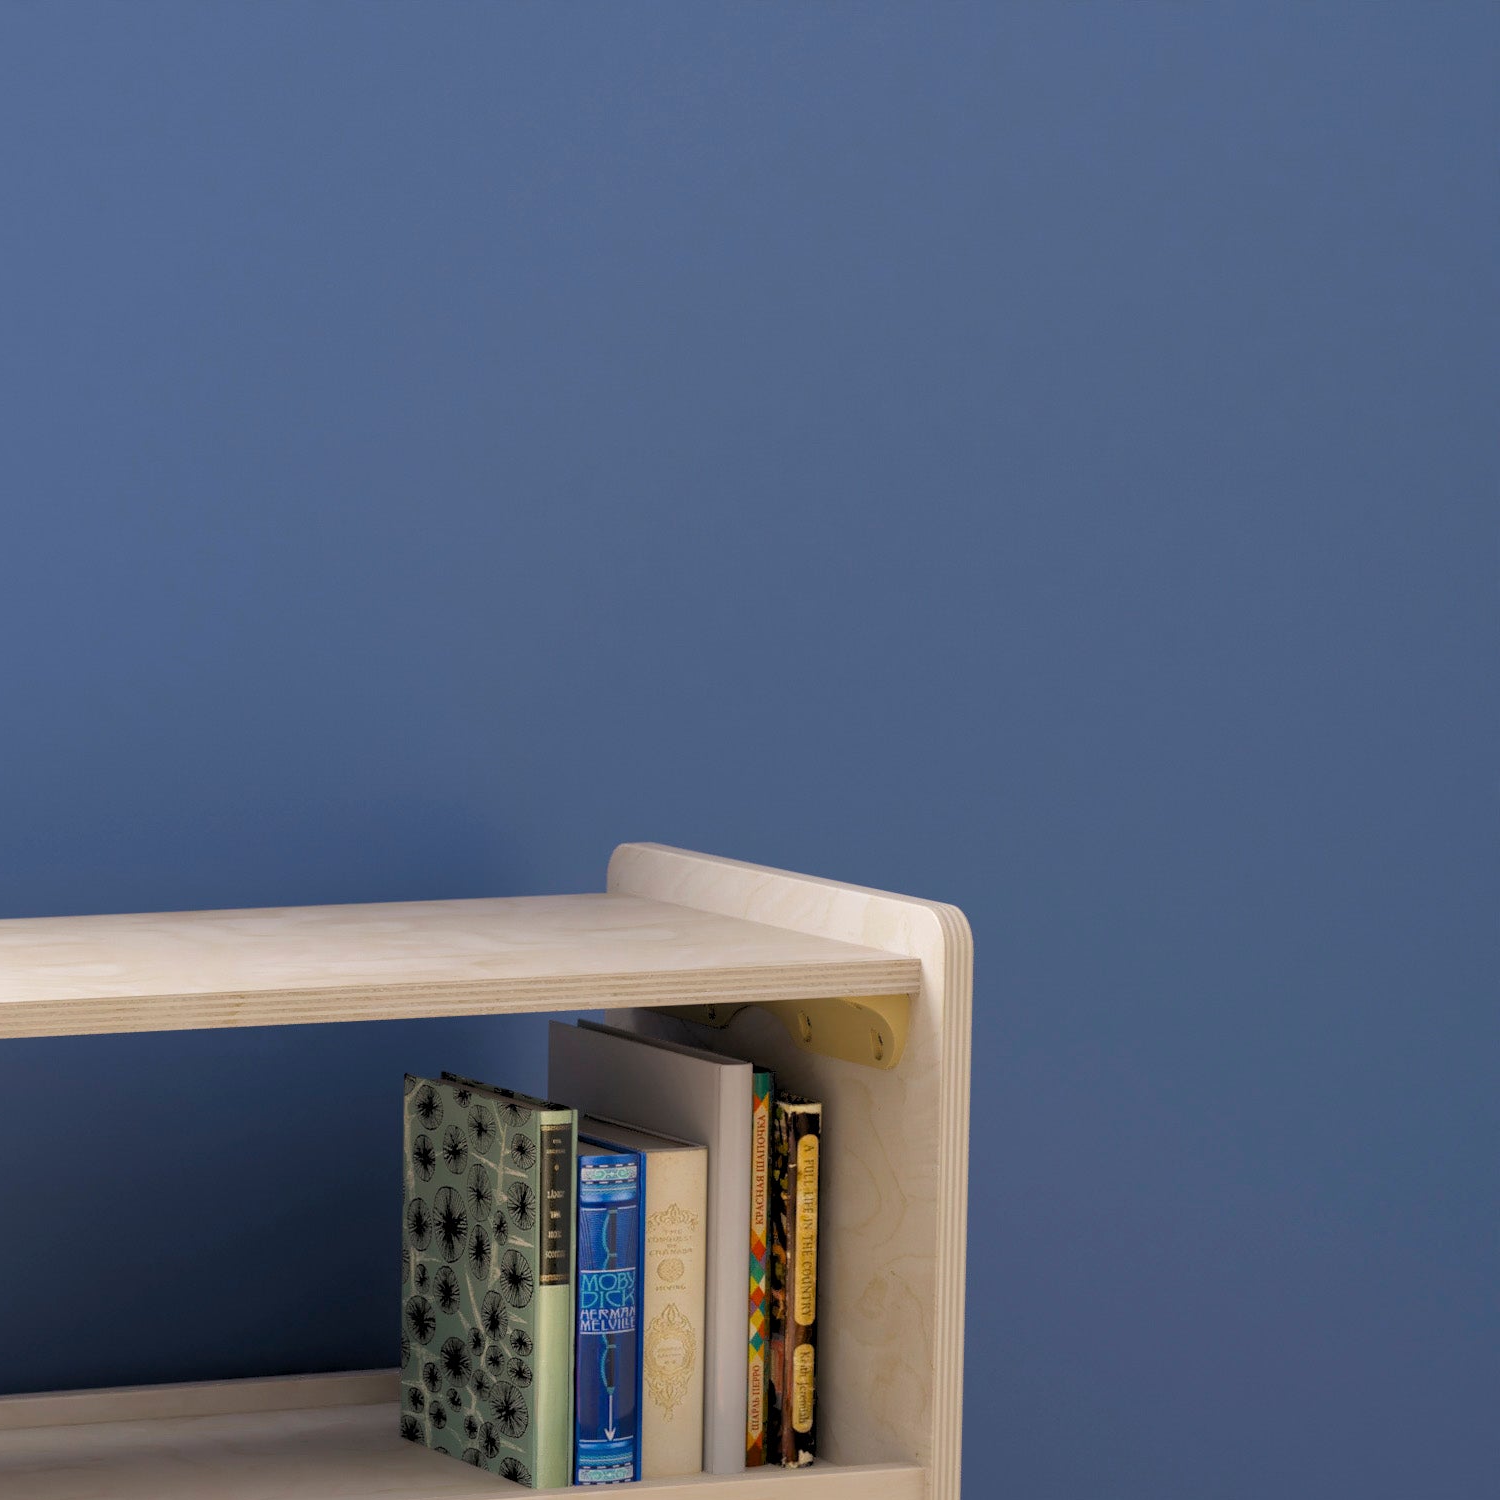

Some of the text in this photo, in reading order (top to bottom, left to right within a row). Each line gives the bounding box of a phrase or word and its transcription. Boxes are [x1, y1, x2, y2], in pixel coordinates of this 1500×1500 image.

[805, 1144, 814, 1152] A
[756, 1115, 766, 1224] КРАСНАЯ ШАПОЧКА
[804, 1159, 814, 1186] FULL
[803, 1191, 814, 1214] LIFE
[802, 1234, 813, 1257] THE
[582, 1271, 636, 1292] MOBY
[801, 1261, 812, 1317] COUNTRY
[582, 1289, 635, 1309] DICK
[581, 1306, 636, 1320] HERMAN
[581, 1317, 636, 1331] MELVILLE
